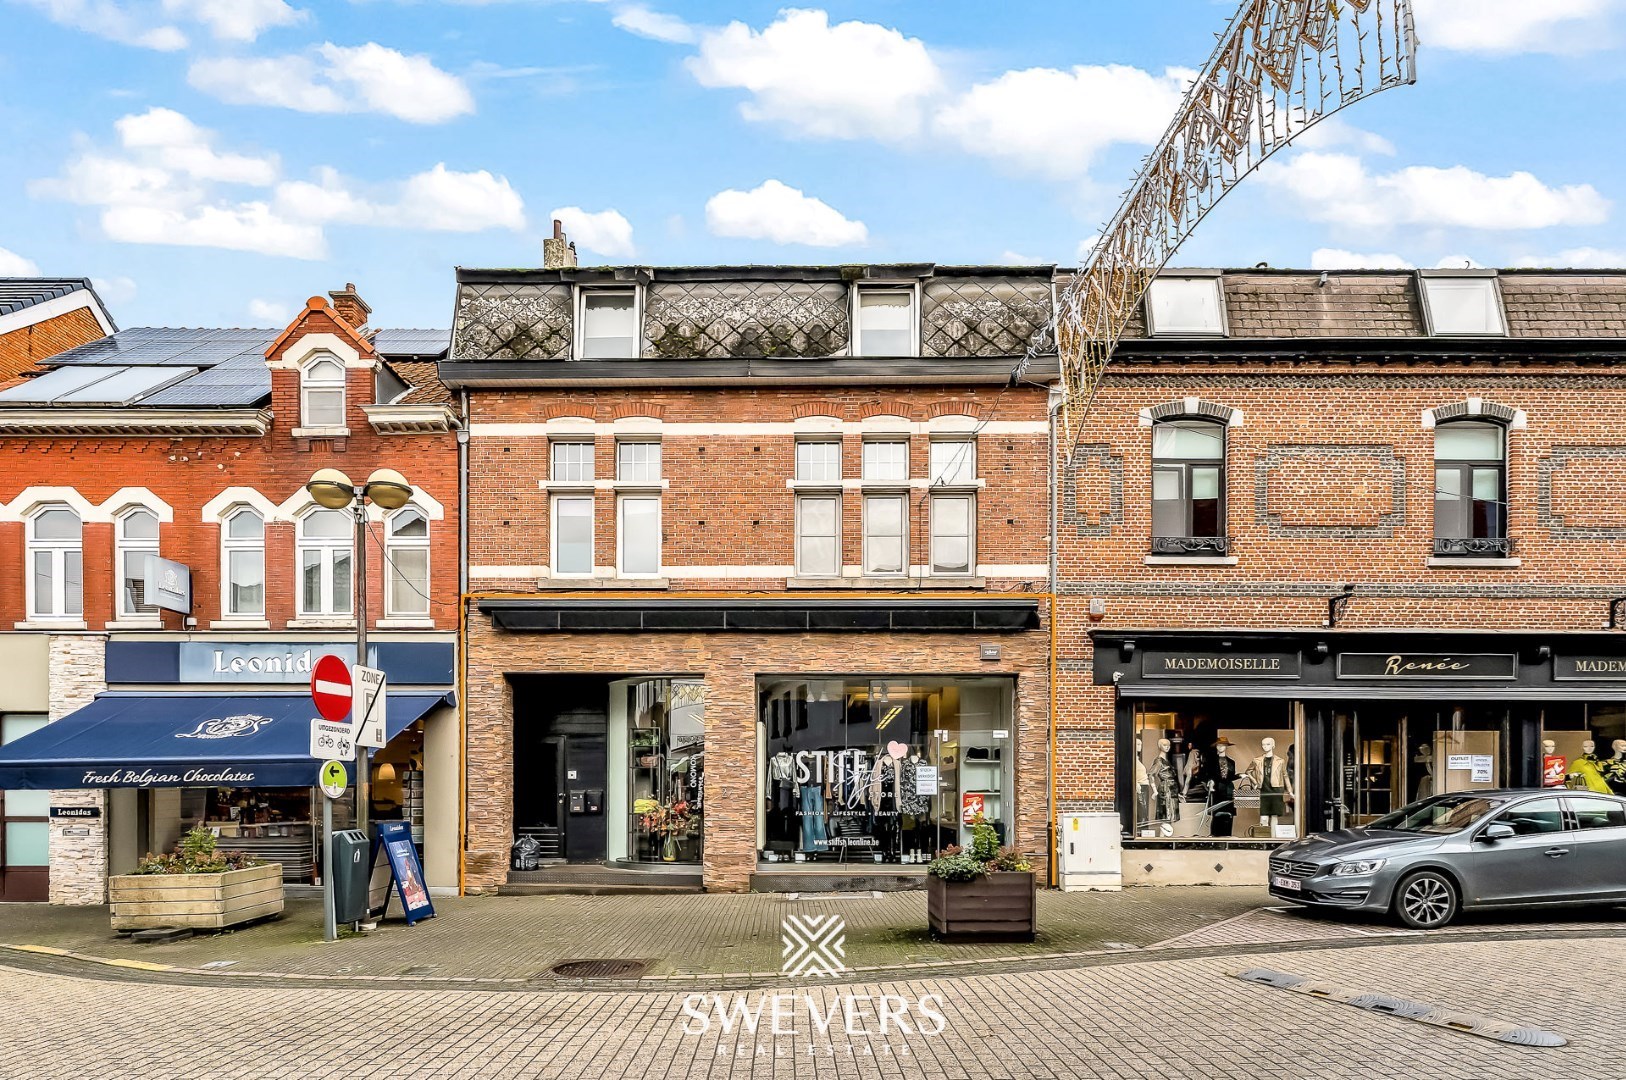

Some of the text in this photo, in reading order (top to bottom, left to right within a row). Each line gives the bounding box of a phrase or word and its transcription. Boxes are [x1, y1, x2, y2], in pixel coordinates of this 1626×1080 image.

[213, 649, 345, 673] Leonid
[1164, 658, 1280, 670] MADEMOISELLE
[1384, 655, 1470, 675] Renée
[1575, 660, 1626, 671] MADEM
[361, 670, 380, 685] ZONE
[82, 767, 256, 787] Fresh Belgian Chocolates
[57, 808, 92, 816] Leonidas
